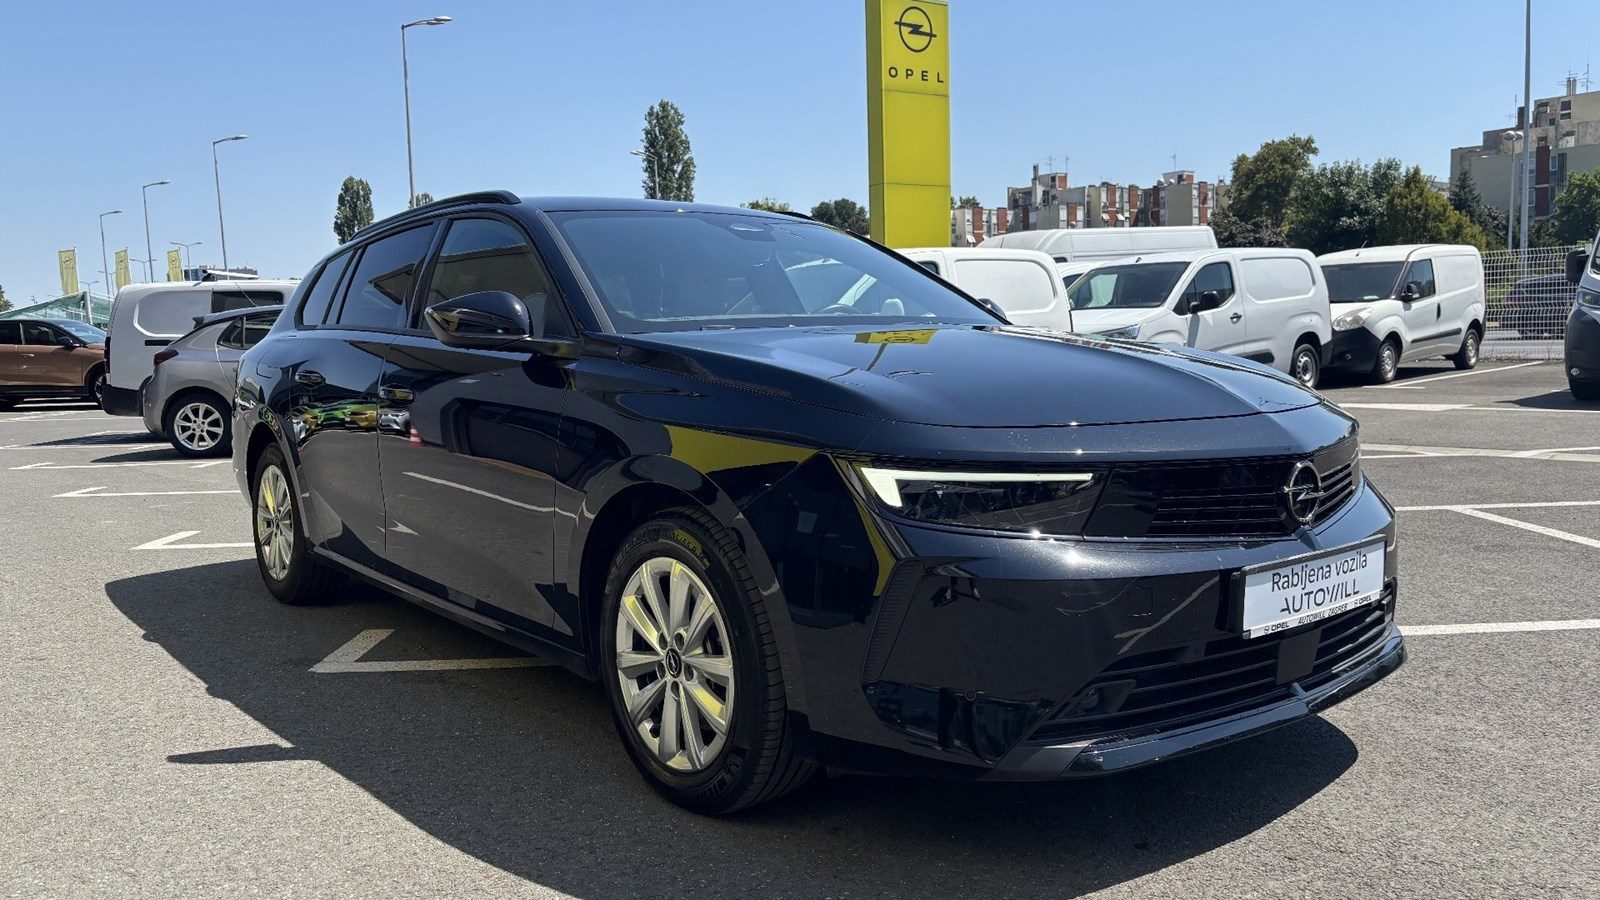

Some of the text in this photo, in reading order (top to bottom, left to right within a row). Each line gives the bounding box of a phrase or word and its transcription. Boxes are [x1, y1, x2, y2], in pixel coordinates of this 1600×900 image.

[888, 66, 945, 84] OPEL
[1271, 550, 1368, 592] Rabljena vozila
[1280, 578, 1360, 614] AUTOWILL
[1271, 621, 1290, 632] OPEL
